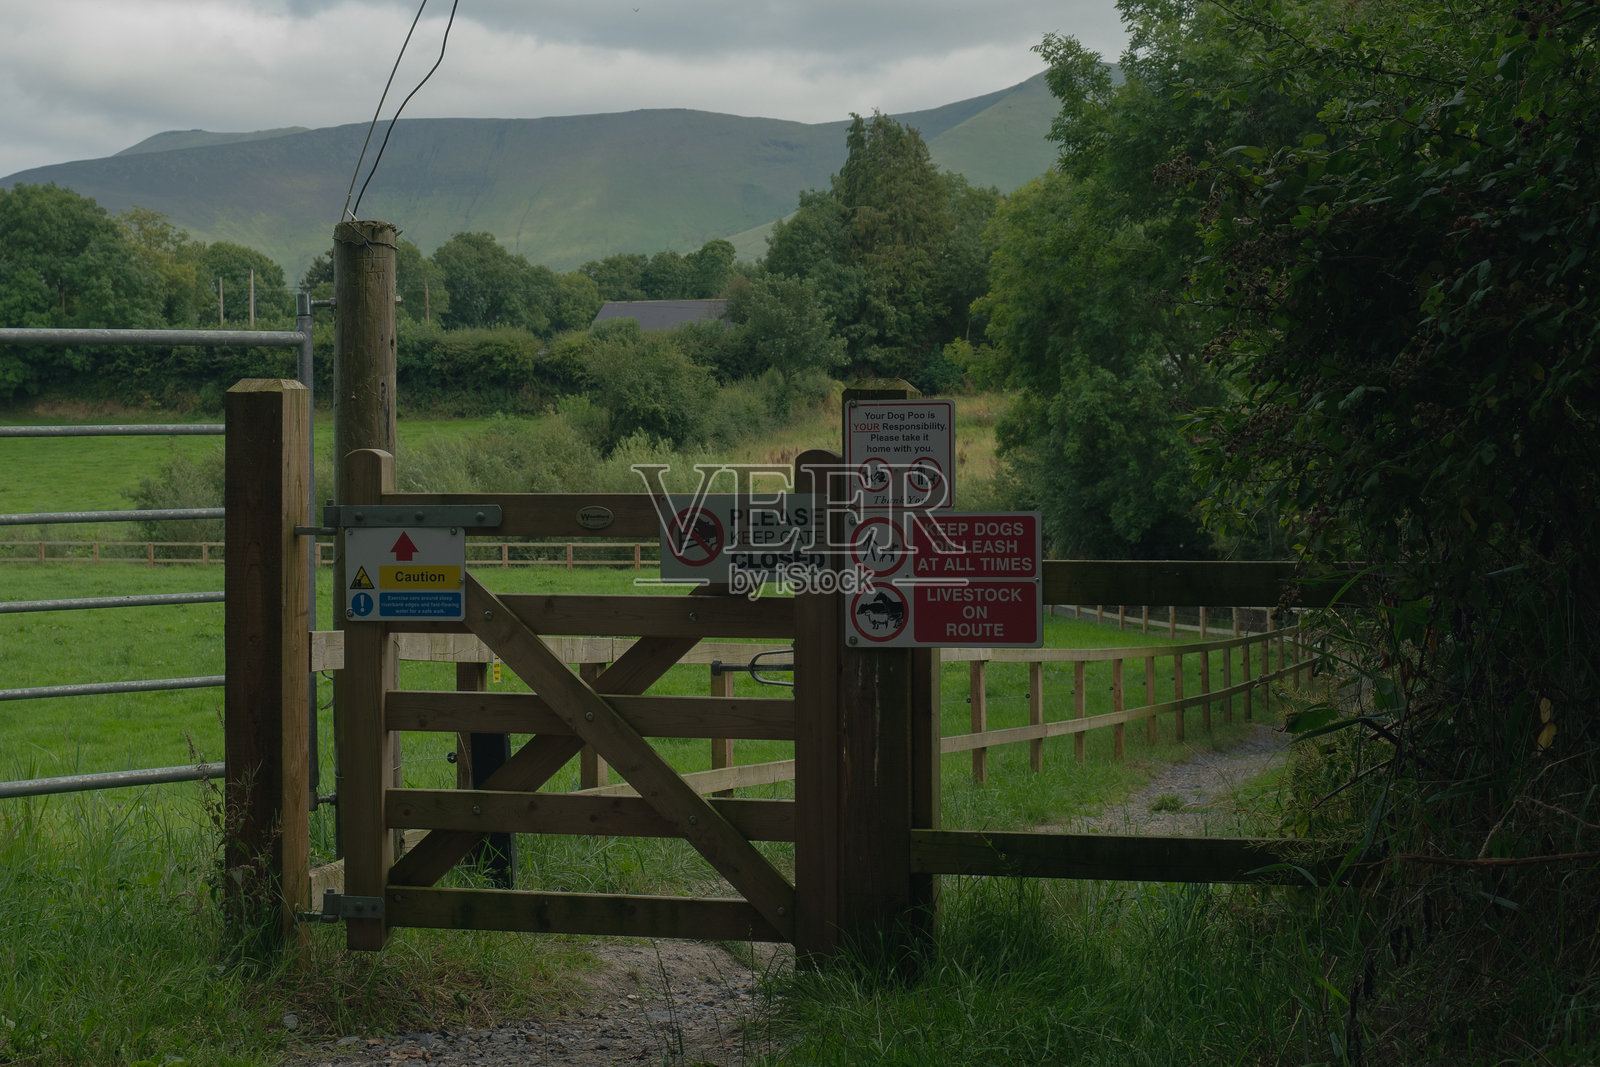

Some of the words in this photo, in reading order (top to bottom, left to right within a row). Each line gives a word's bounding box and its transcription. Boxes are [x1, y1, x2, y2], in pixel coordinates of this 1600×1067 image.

[865, 412, 885, 420] Your
[887, 412, 905, 421] Dog
[908, 411, 925, 419] Poo
[927, 411, 936, 419] is
[853, 423, 880, 431] YOUR
[882, 422, 947, 432] Responsibility.
[923, 433, 929, 441] it
[914, 446, 934, 454] you.
[730, 508, 825, 526] PLEASE
[924, 522, 969, 536] KEEP
[974, 522, 1024, 536] DOGS
[730, 530, 775, 545] KEEP
[931, 540, 957, 554] ON
[961, 540, 1018, 554] LEASH
[731, 551, 825, 569] CLOSED
[917, 557, 939, 571] AT
[943, 557, 975, 571] ALL
[980, 557, 1033, 571] TIMES
[395, 571, 445, 582] Caution
[926, 588, 1023, 602] LIVESTOCK
[962, 605, 988, 619] ON
[946, 623, 1005, 637] ROUTE
